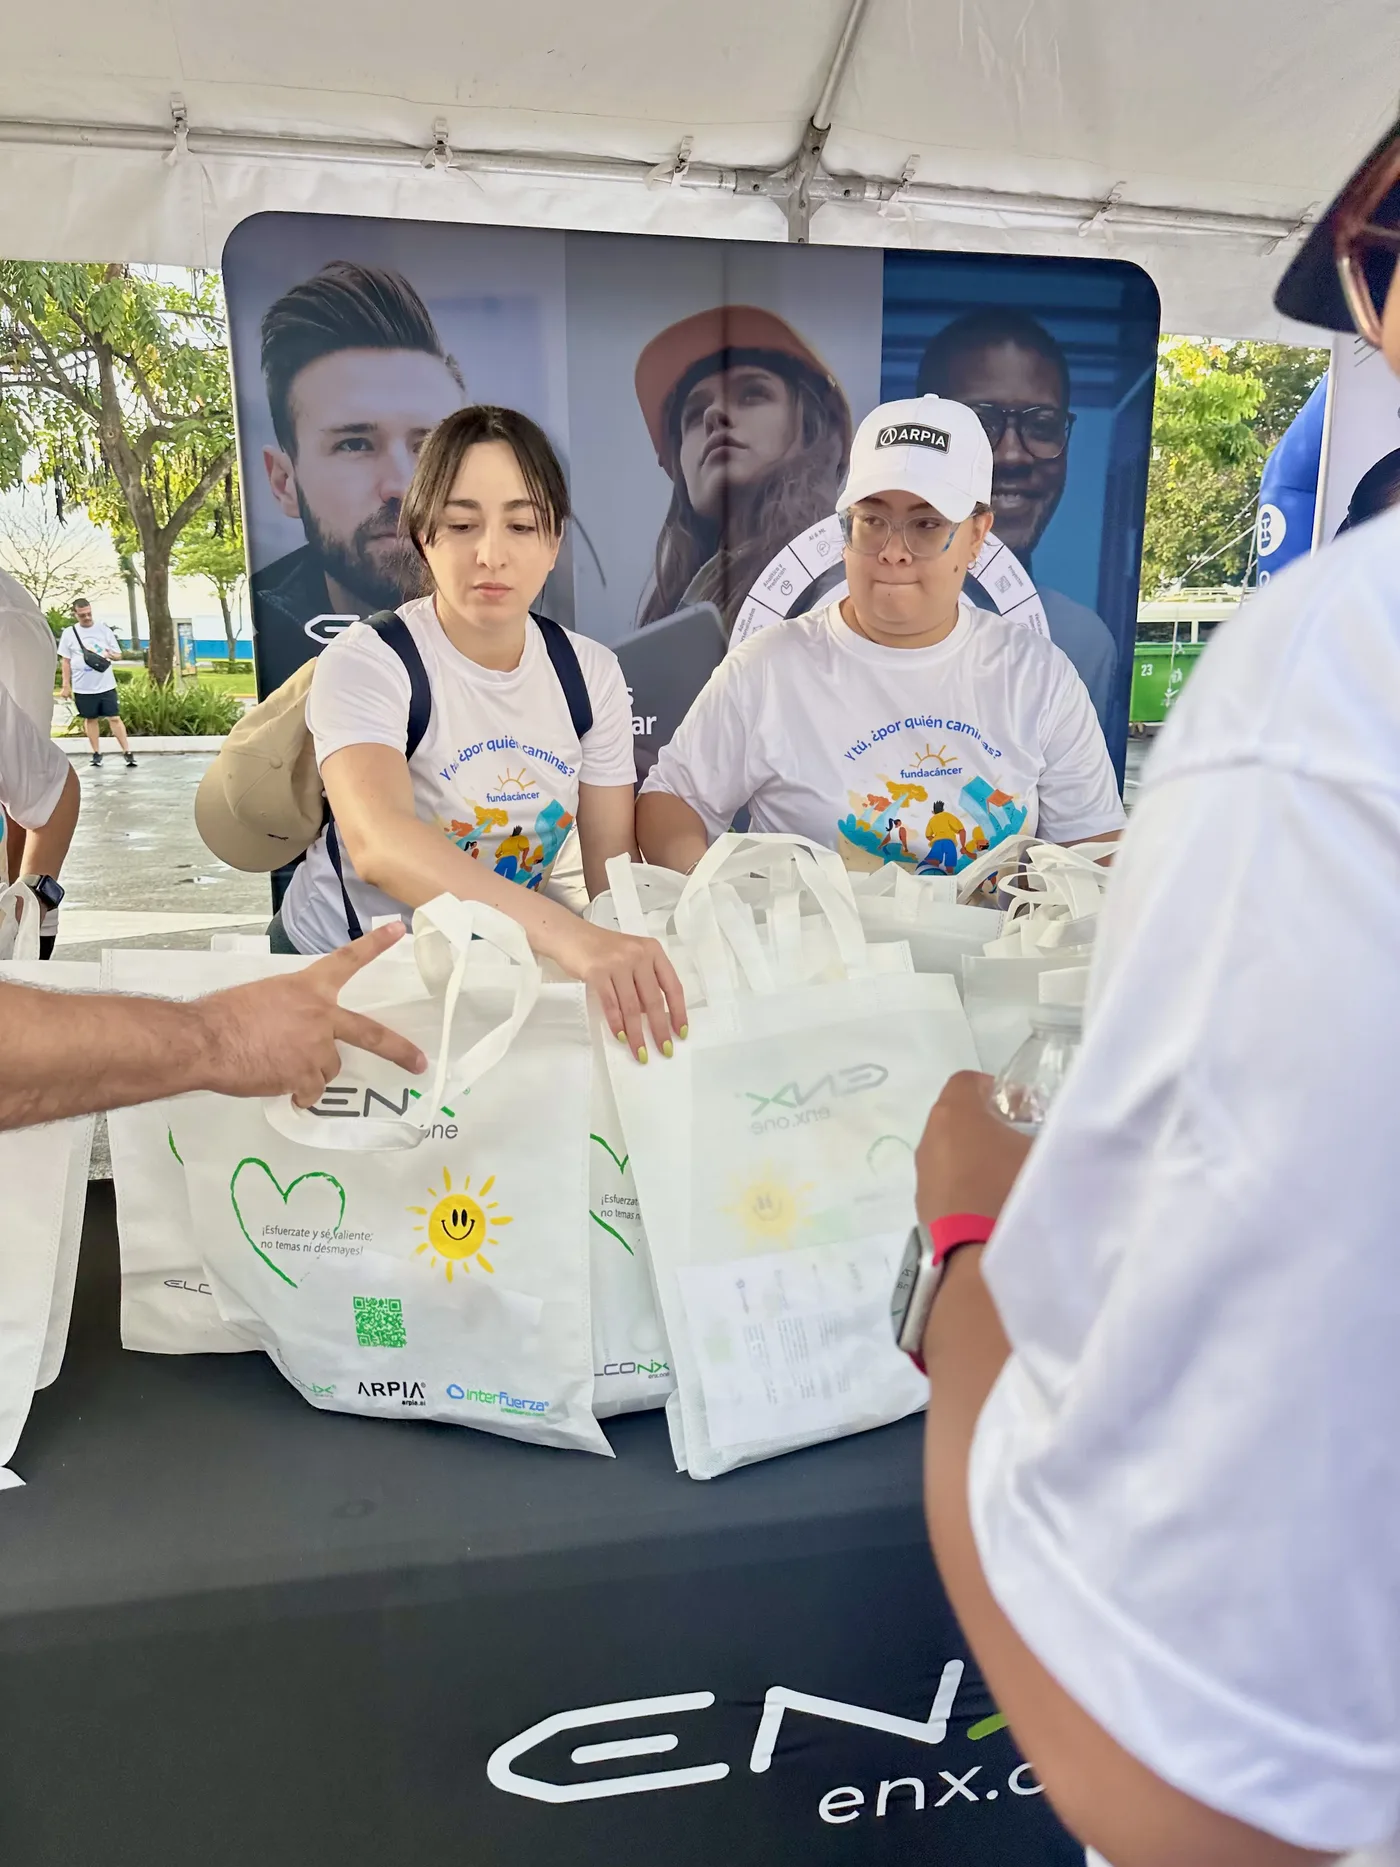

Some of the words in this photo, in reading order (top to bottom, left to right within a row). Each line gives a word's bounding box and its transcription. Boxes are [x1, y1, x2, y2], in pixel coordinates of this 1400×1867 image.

[898, 428, 946, 448] ARPIA
[1141, 663, 1153, 677] 23
[844, 752, 856, 762] Y
[851, 739, 873, 756] tú,
[871, 720, 901, 742] ¿por
[904, 715, 943, 730] quién
[458, 741, 484, 762] ¿por
[522, 744, 575, 778] caminas?
[900, 766, 963, 779] fundacáncer
[486, 791, 540, 803] fundacáncer
[600, 1209, 613, 1217] no
[615, 1209, 634, 1220] temas
[262, 1225, 310, 1238] ¡Esfuerzate
[312, 1230, 319, 1240] y
[260, 1240, 273, 1249] no
[275, 1240, 301, 1252] temas
[302, 1242, 312, 1253] ni
[314, 1243, 364, 1257] desmayes!
[358, 1381, 424, 1399] ARPIA
